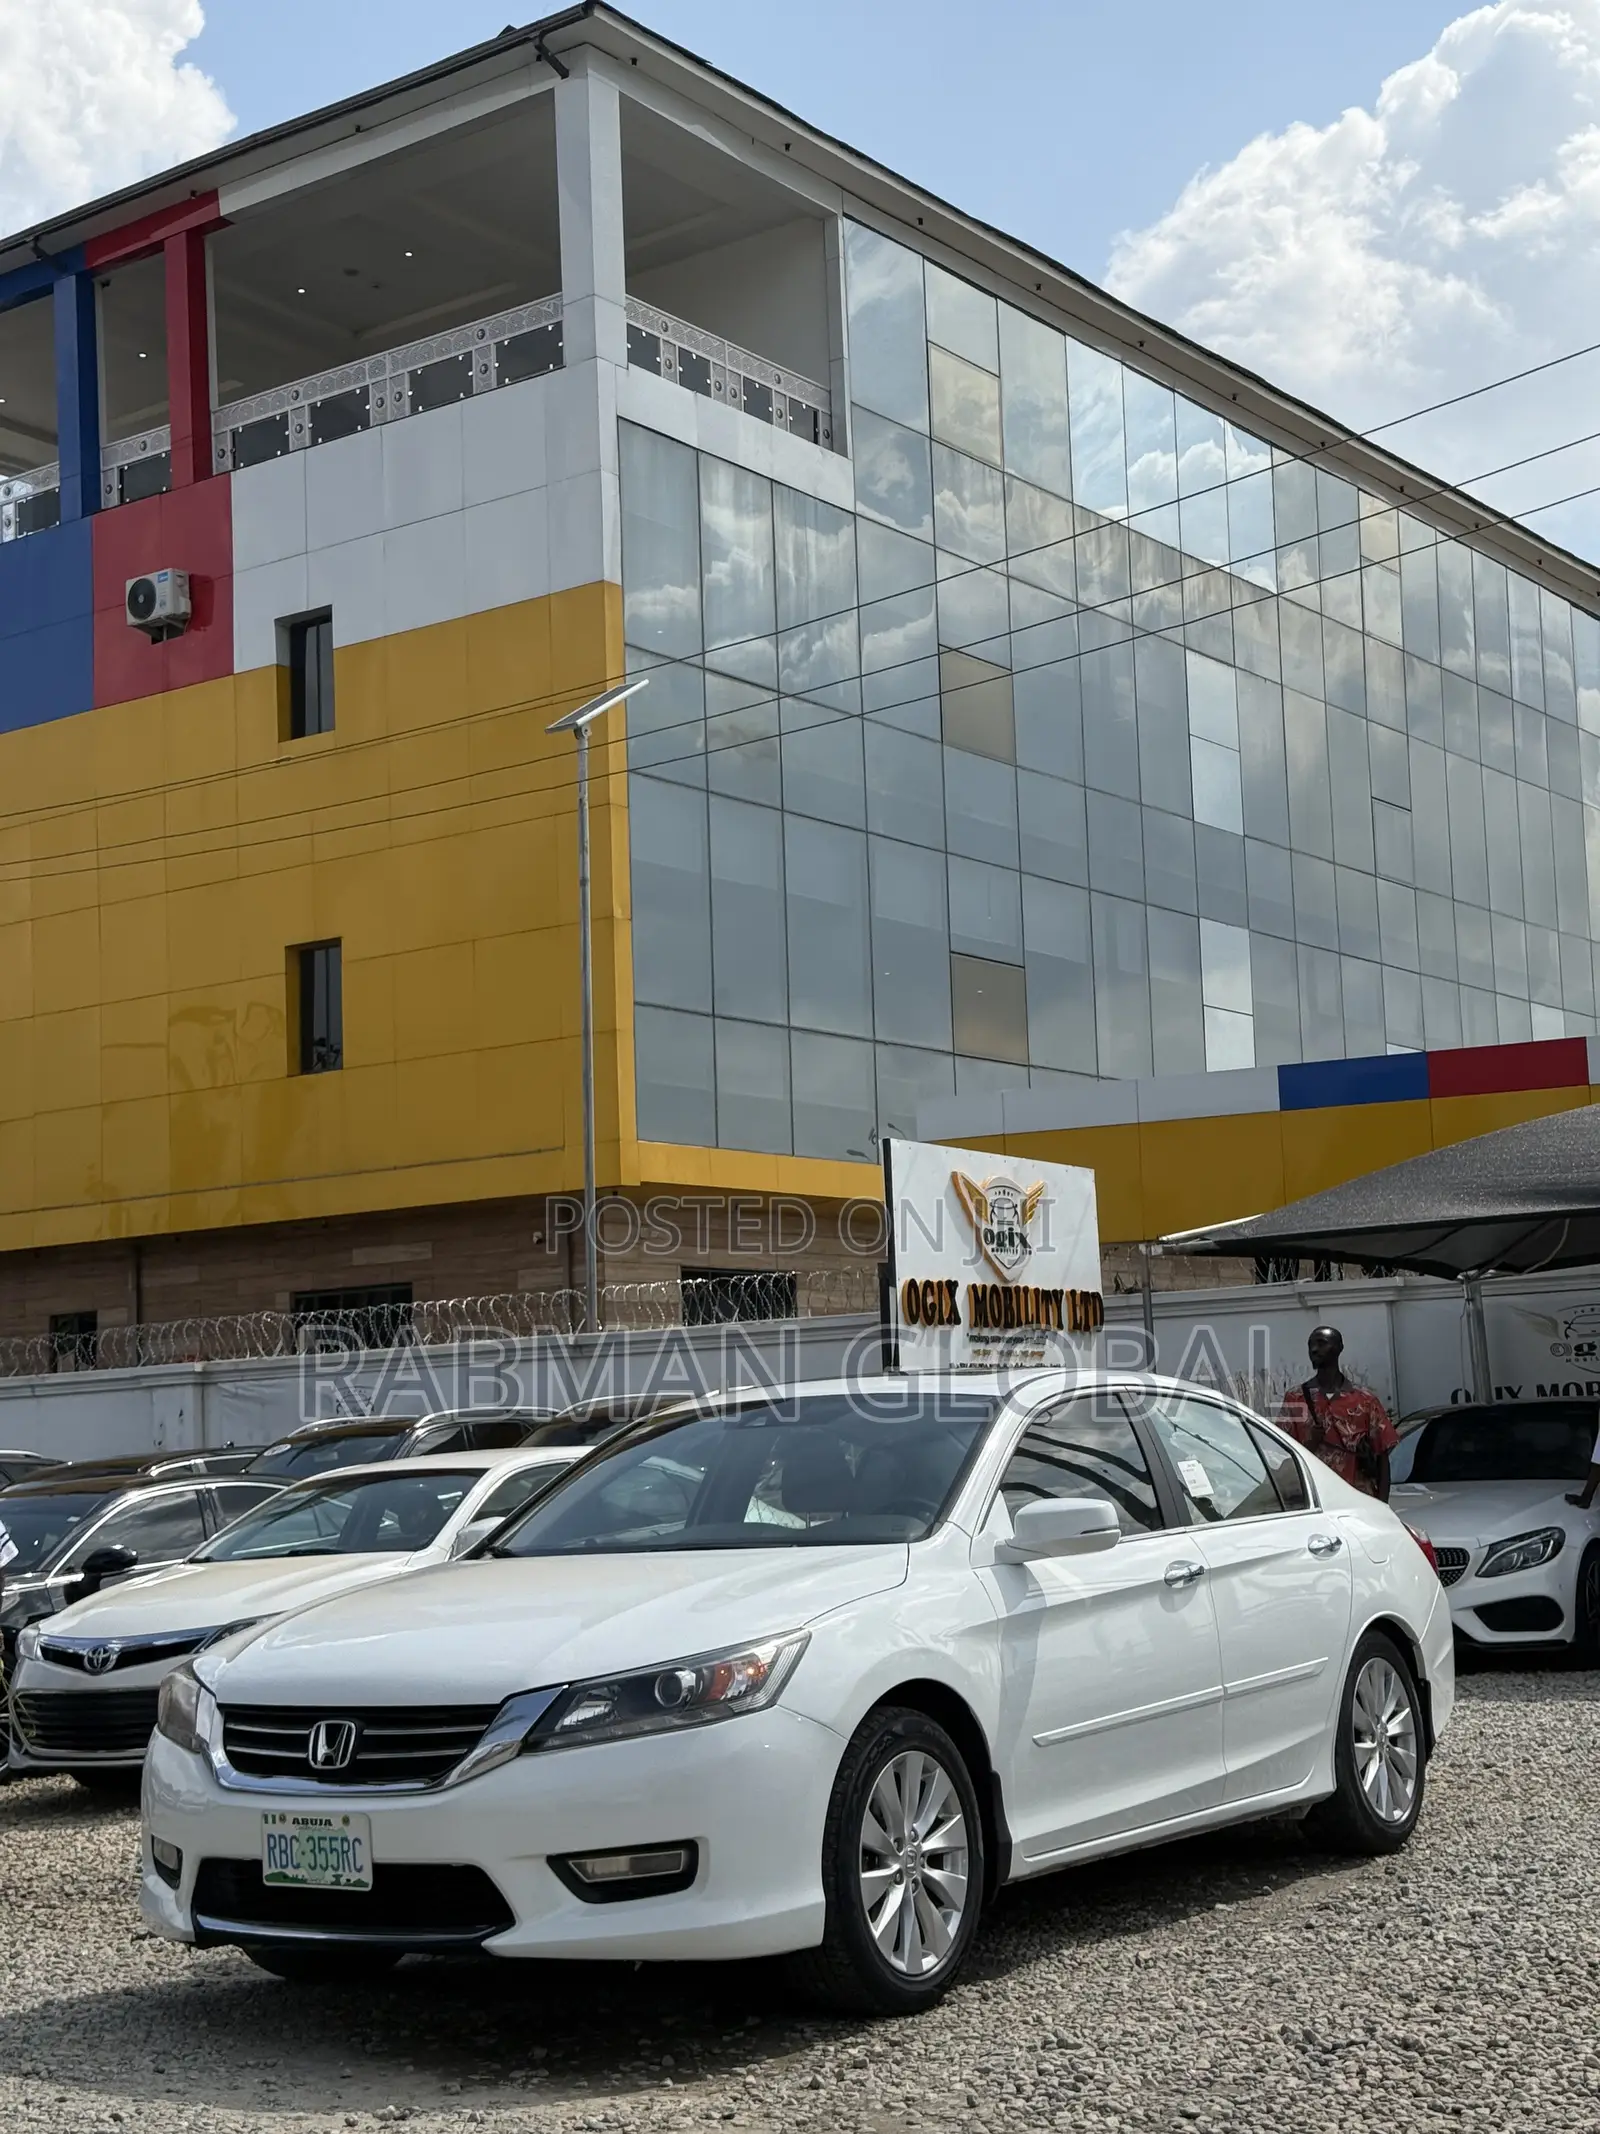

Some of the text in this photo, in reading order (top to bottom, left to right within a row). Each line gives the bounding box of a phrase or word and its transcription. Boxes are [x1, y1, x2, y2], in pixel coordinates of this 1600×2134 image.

[902, 1278, 1104, 1332] OGIX MOBILITY LTD
[292, 1817, 333, 1827] ABUJA
